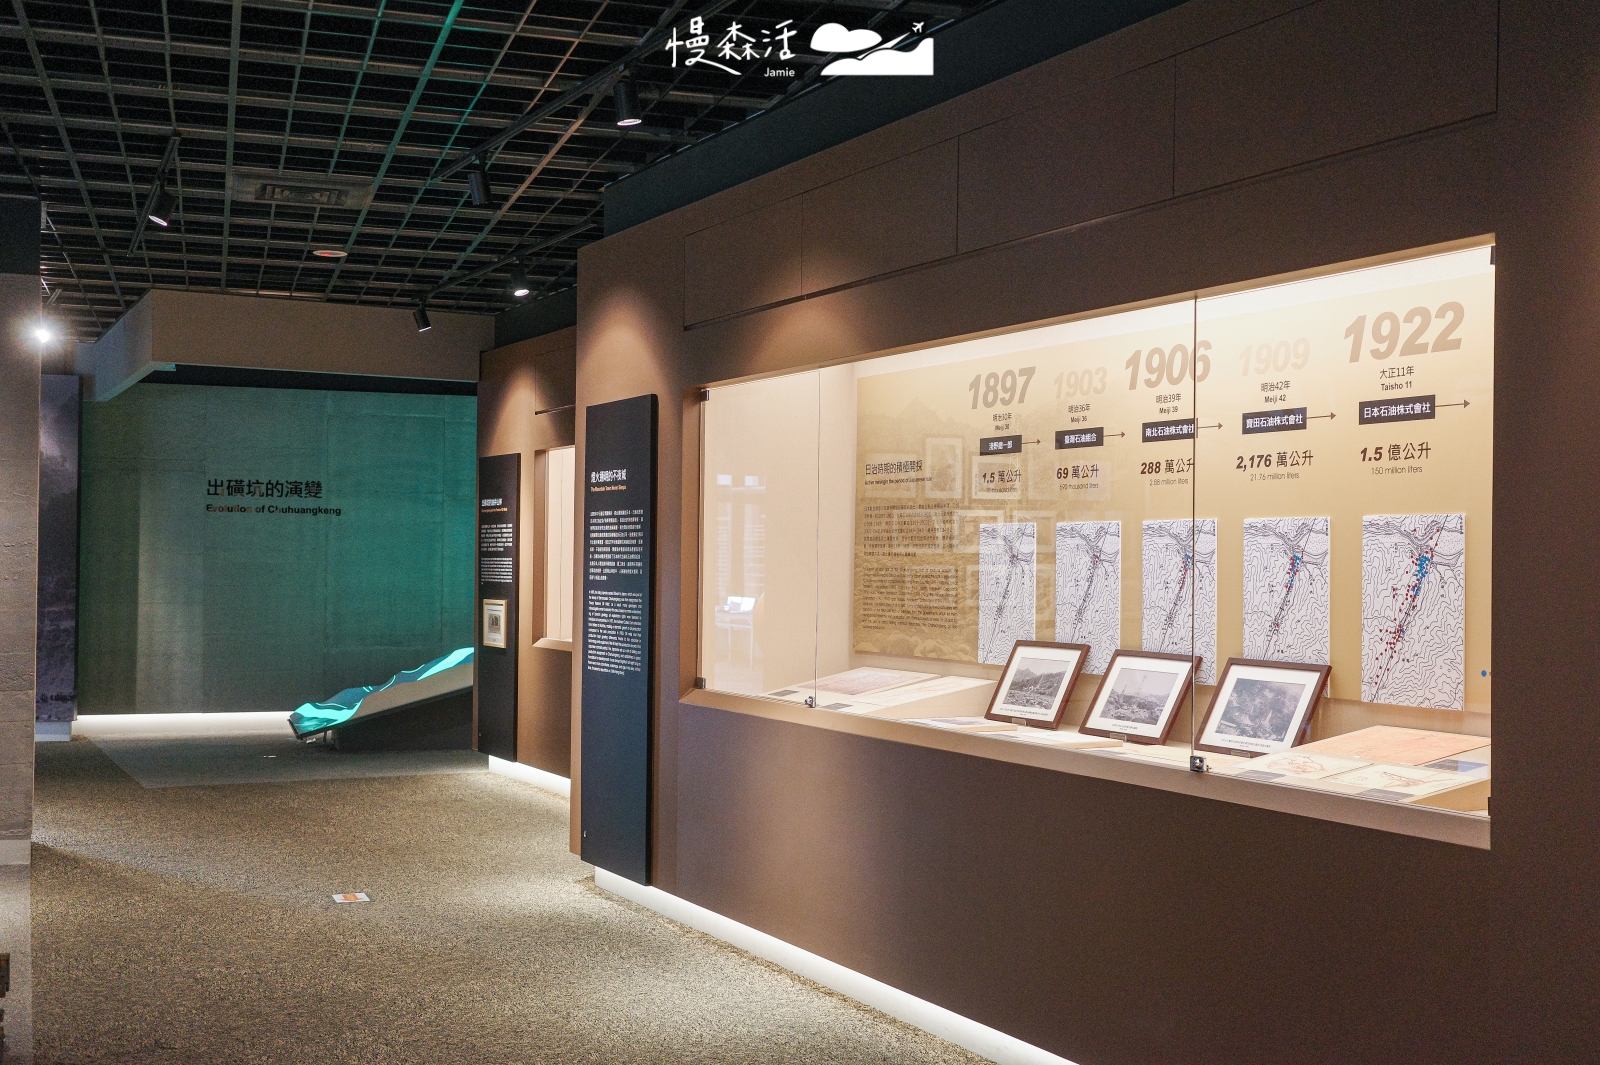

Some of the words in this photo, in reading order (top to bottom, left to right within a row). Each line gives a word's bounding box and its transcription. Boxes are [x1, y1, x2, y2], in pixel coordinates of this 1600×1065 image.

[1343, 301, 1465, 364] 1922
[1238, 337, 1311, 377] 1909
[1125, 340, 1212, 390] 1906
[1379, 365, 1415, 379] 大正11年
[968, 366, 1036, 410] 1897
[1053, 366, 1108, 400] 1903
[1260, 380, 1290, 394] 明治42年
[1381, 382, 1403, 391] Taisho
[1405, 380, 1412, 389] 11
[1156, 393, 1182, 404] 明治39年
[1264, 395, 1278, 404] Meiji
[1279, 394, 1287, 403] 42
[1068, 403, 1091, 414] 明治36年
[1159, 406, 1171, 415] Meiji
[1172, 405, 1179, 413] 39
[1364, 402, 1431, 419] 日本石油株式會社
[1245, 414, 1304, 429] 寶田石油株式會社
[1145, 424, 1195, 437] 南北石油株式會社
[1360, 446, 1383, 463] 1.5
[1387, 442, 1432, 461] 億公升
[1140, 461, 1161, 475] 288
[1164, 457, 1195, 474] 萬公升
[1236, 453, 1272, 473] 2,176
[1276, 449, 1314, 468] 萬公升
[983, 472, 995, 484] 1.5
[997, 469, 1022, 483] 萬公升
[1056, 467, 1069, 480] 69
[1071, 463, 1100, 480] 萬公升
[1266, 472, 1286, 481] million
[1371, 467, 1383, 476] 150
[1384, 465, 1406, 475] million
[207, 478, 323, 499] 出磺坑的演變
[206, 503, 252, 513] Evolution
[256, 504, 265, 513] of
[268, 505, 342, 516] Chuhuangkeng
